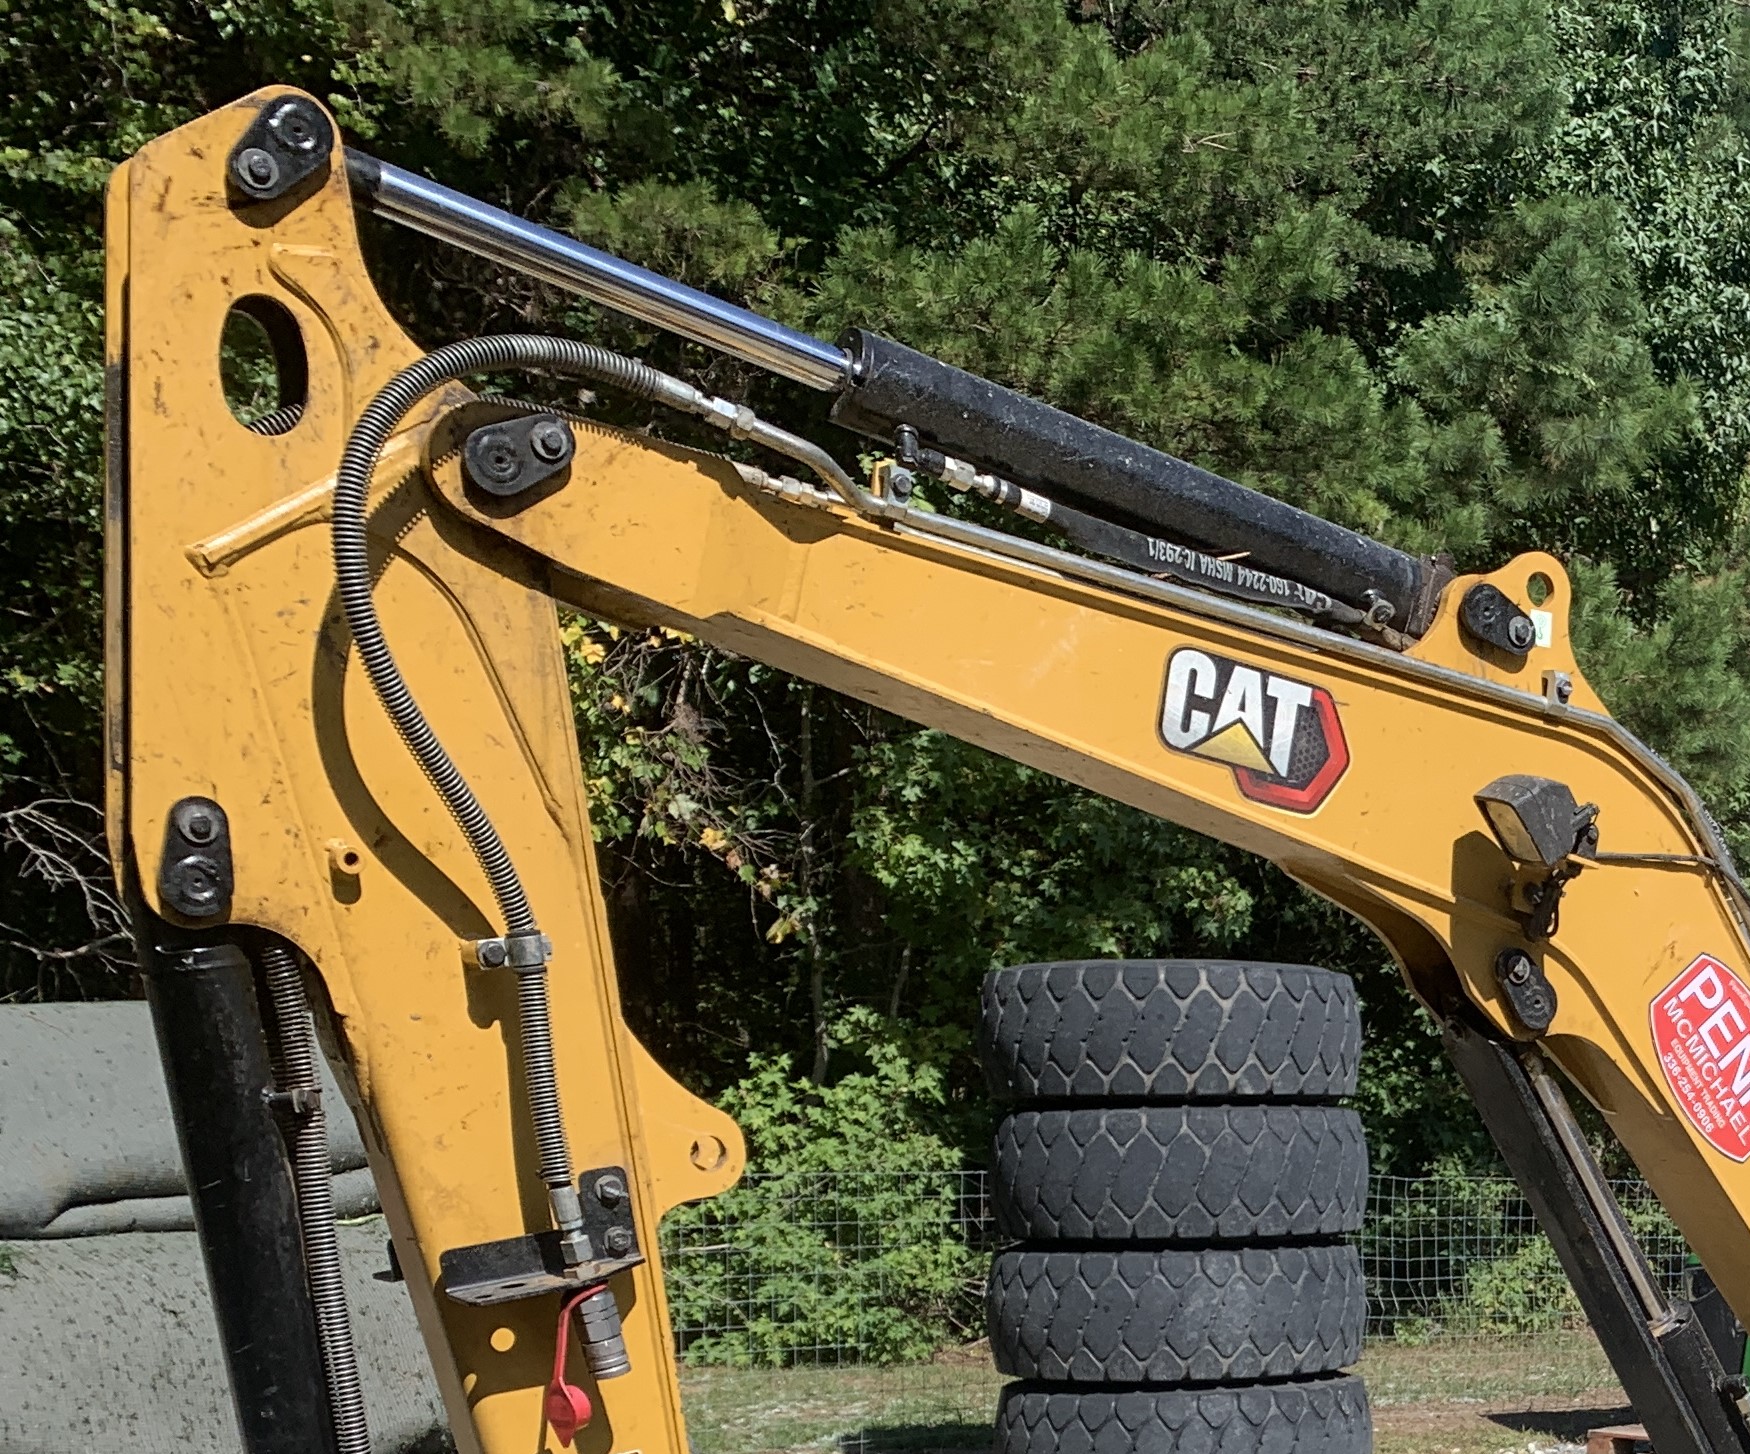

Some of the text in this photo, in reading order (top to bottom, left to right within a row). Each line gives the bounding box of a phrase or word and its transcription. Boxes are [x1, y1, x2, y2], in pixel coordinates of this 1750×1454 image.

[1200, 552, 1234, 582] MSHA
[1236, 565, 1290, 597] 160-2244
[1162, 649, 1314, 778] CAT
[1663, 1052, 1715, 1134] 336-254-0906
[1670, 1037, 1727, 1130] EQUIPMENT TRADING
